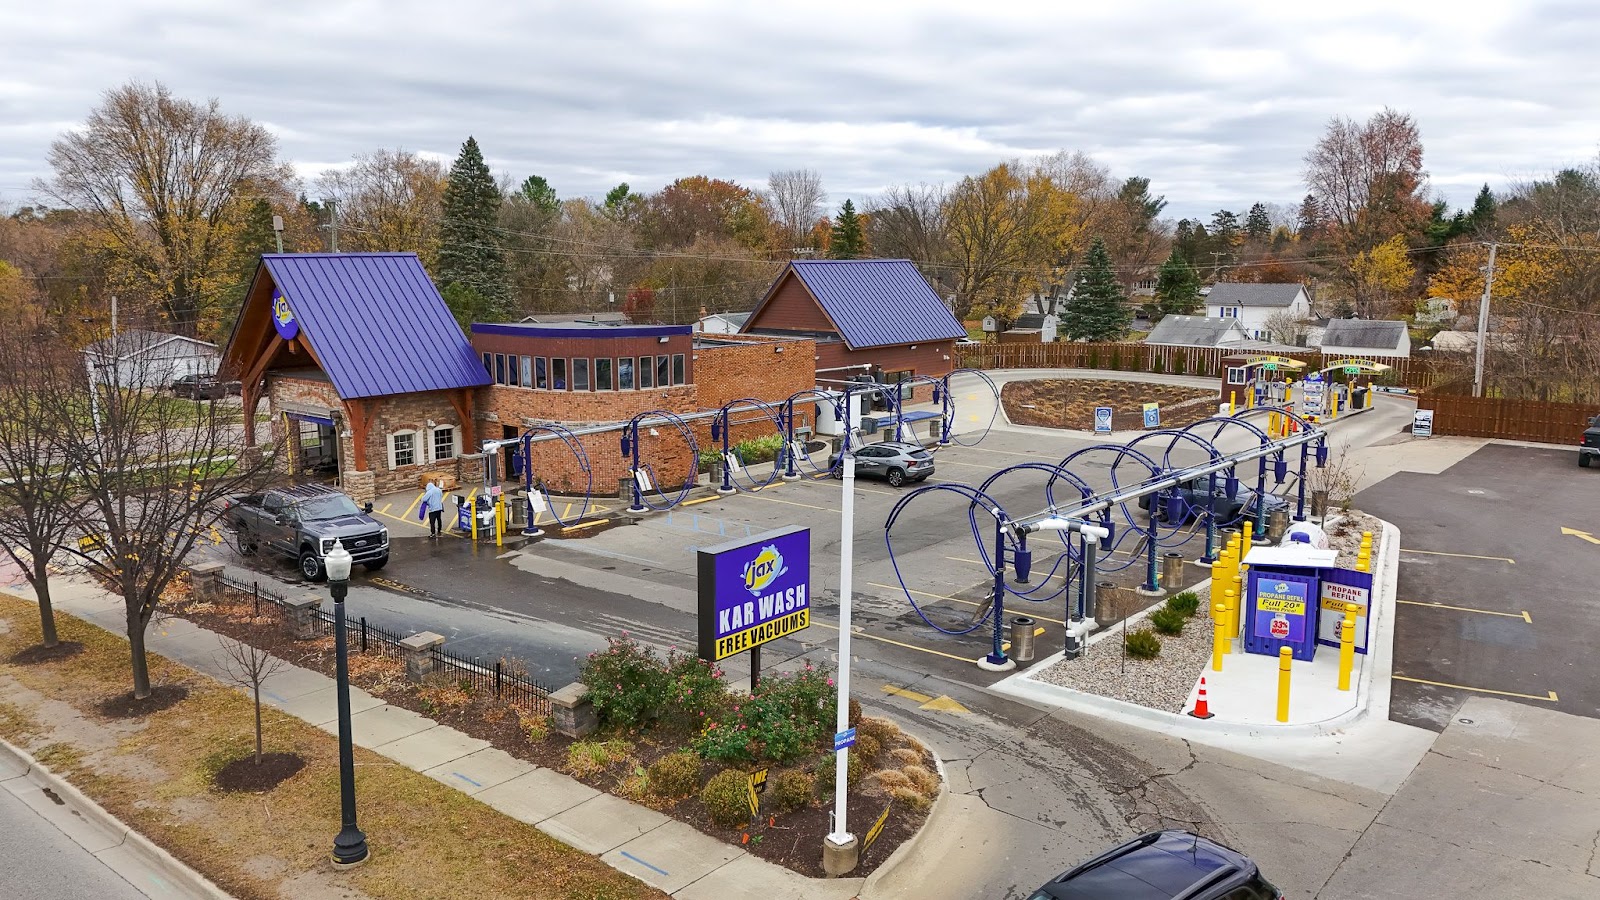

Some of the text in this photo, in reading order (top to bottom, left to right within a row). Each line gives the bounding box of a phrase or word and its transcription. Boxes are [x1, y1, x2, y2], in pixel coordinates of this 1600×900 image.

[276, 299, 288, 319] ja
[745, 560, 775, 590] jax
[1259, 592, 1304, 602] PROPANE REFILL
[1327, 584, 1362, 597] PROPANE
[1331, 592, 1357, 602] REFILL
[720, 584, 806, 635] KAR WASH
[1262, 599, 1281, 607] Full
[1272, 620, 1288, 629] 33%
[719, 612, 806, 656] FREE VACUUMS
